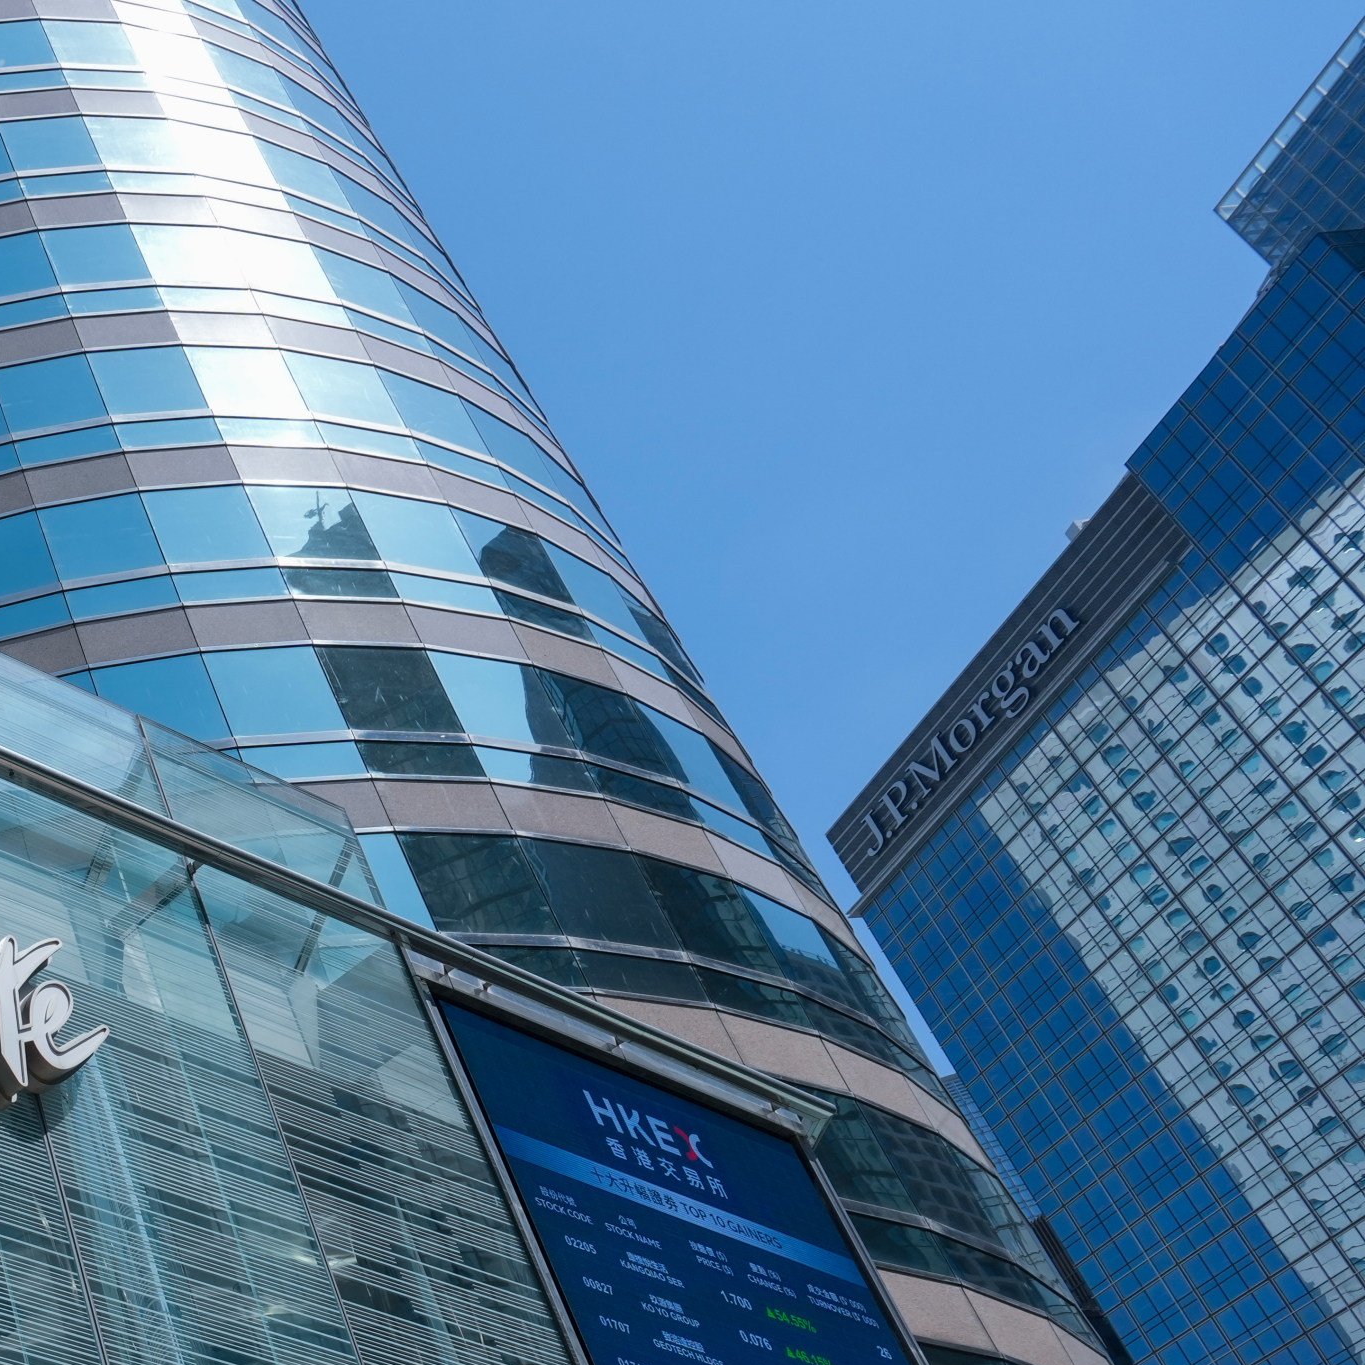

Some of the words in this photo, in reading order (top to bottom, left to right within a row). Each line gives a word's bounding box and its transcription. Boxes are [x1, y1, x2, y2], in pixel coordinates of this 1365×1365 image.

[582, 1089, 713, 1168] HKEX
[605, 1136, 728, 1199] 香港交易所
[534, 1196, 567, 1215] STOCK
[566, 1208, 593, 1225] CODE
[604, 1221, 635, 1240] STOCK
[634, 1232, 662, 1250] NAME
[678, 1200, 707, 1221] TOP
[708, 1212, 726, 1229] 10
[726, 1219, 785, 1252] GAINERS
[564, 1234, 597, 1255] 02205
[619, 1258, 666, 1282] KANGQIAO
[695, 1254, 723, 1271] PRICE
[582, 1275, 613, 1295] 00827
[746, 1273, 784, 1293] CHANGE
[720, 1289, 753, 1311] 1.700
[806, 1294, 853, 1318] TURNOVER
[598, 1314, 630, 1334] 01707
[640, 1301, 656, 1313] KO
[654, 1305, 669, 1318] YO
[669, 1310, 700, 1328] GROUP
[652, 1337, 696, 1359] GEOTECH
[738, 1329, 773, 1351] 0.076
[875, 1344, 893, 1360] 26
